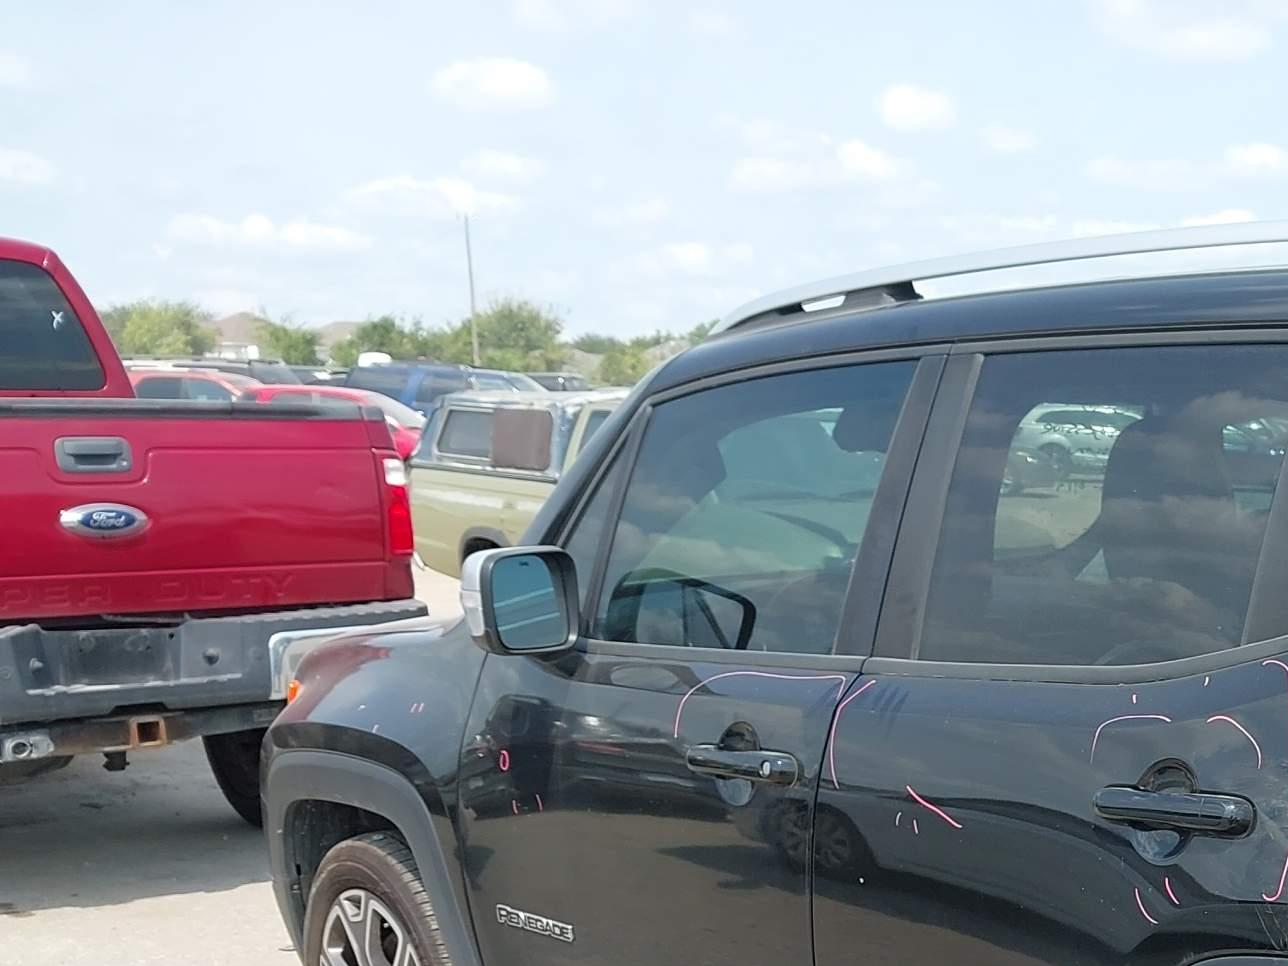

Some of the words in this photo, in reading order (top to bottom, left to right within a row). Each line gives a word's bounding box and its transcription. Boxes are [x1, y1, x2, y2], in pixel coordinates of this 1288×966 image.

[90, 511, 126, 527] Ford
[150, 573, 296, 602] DUTY
[496, 903, 575, 943] RENEGADE
